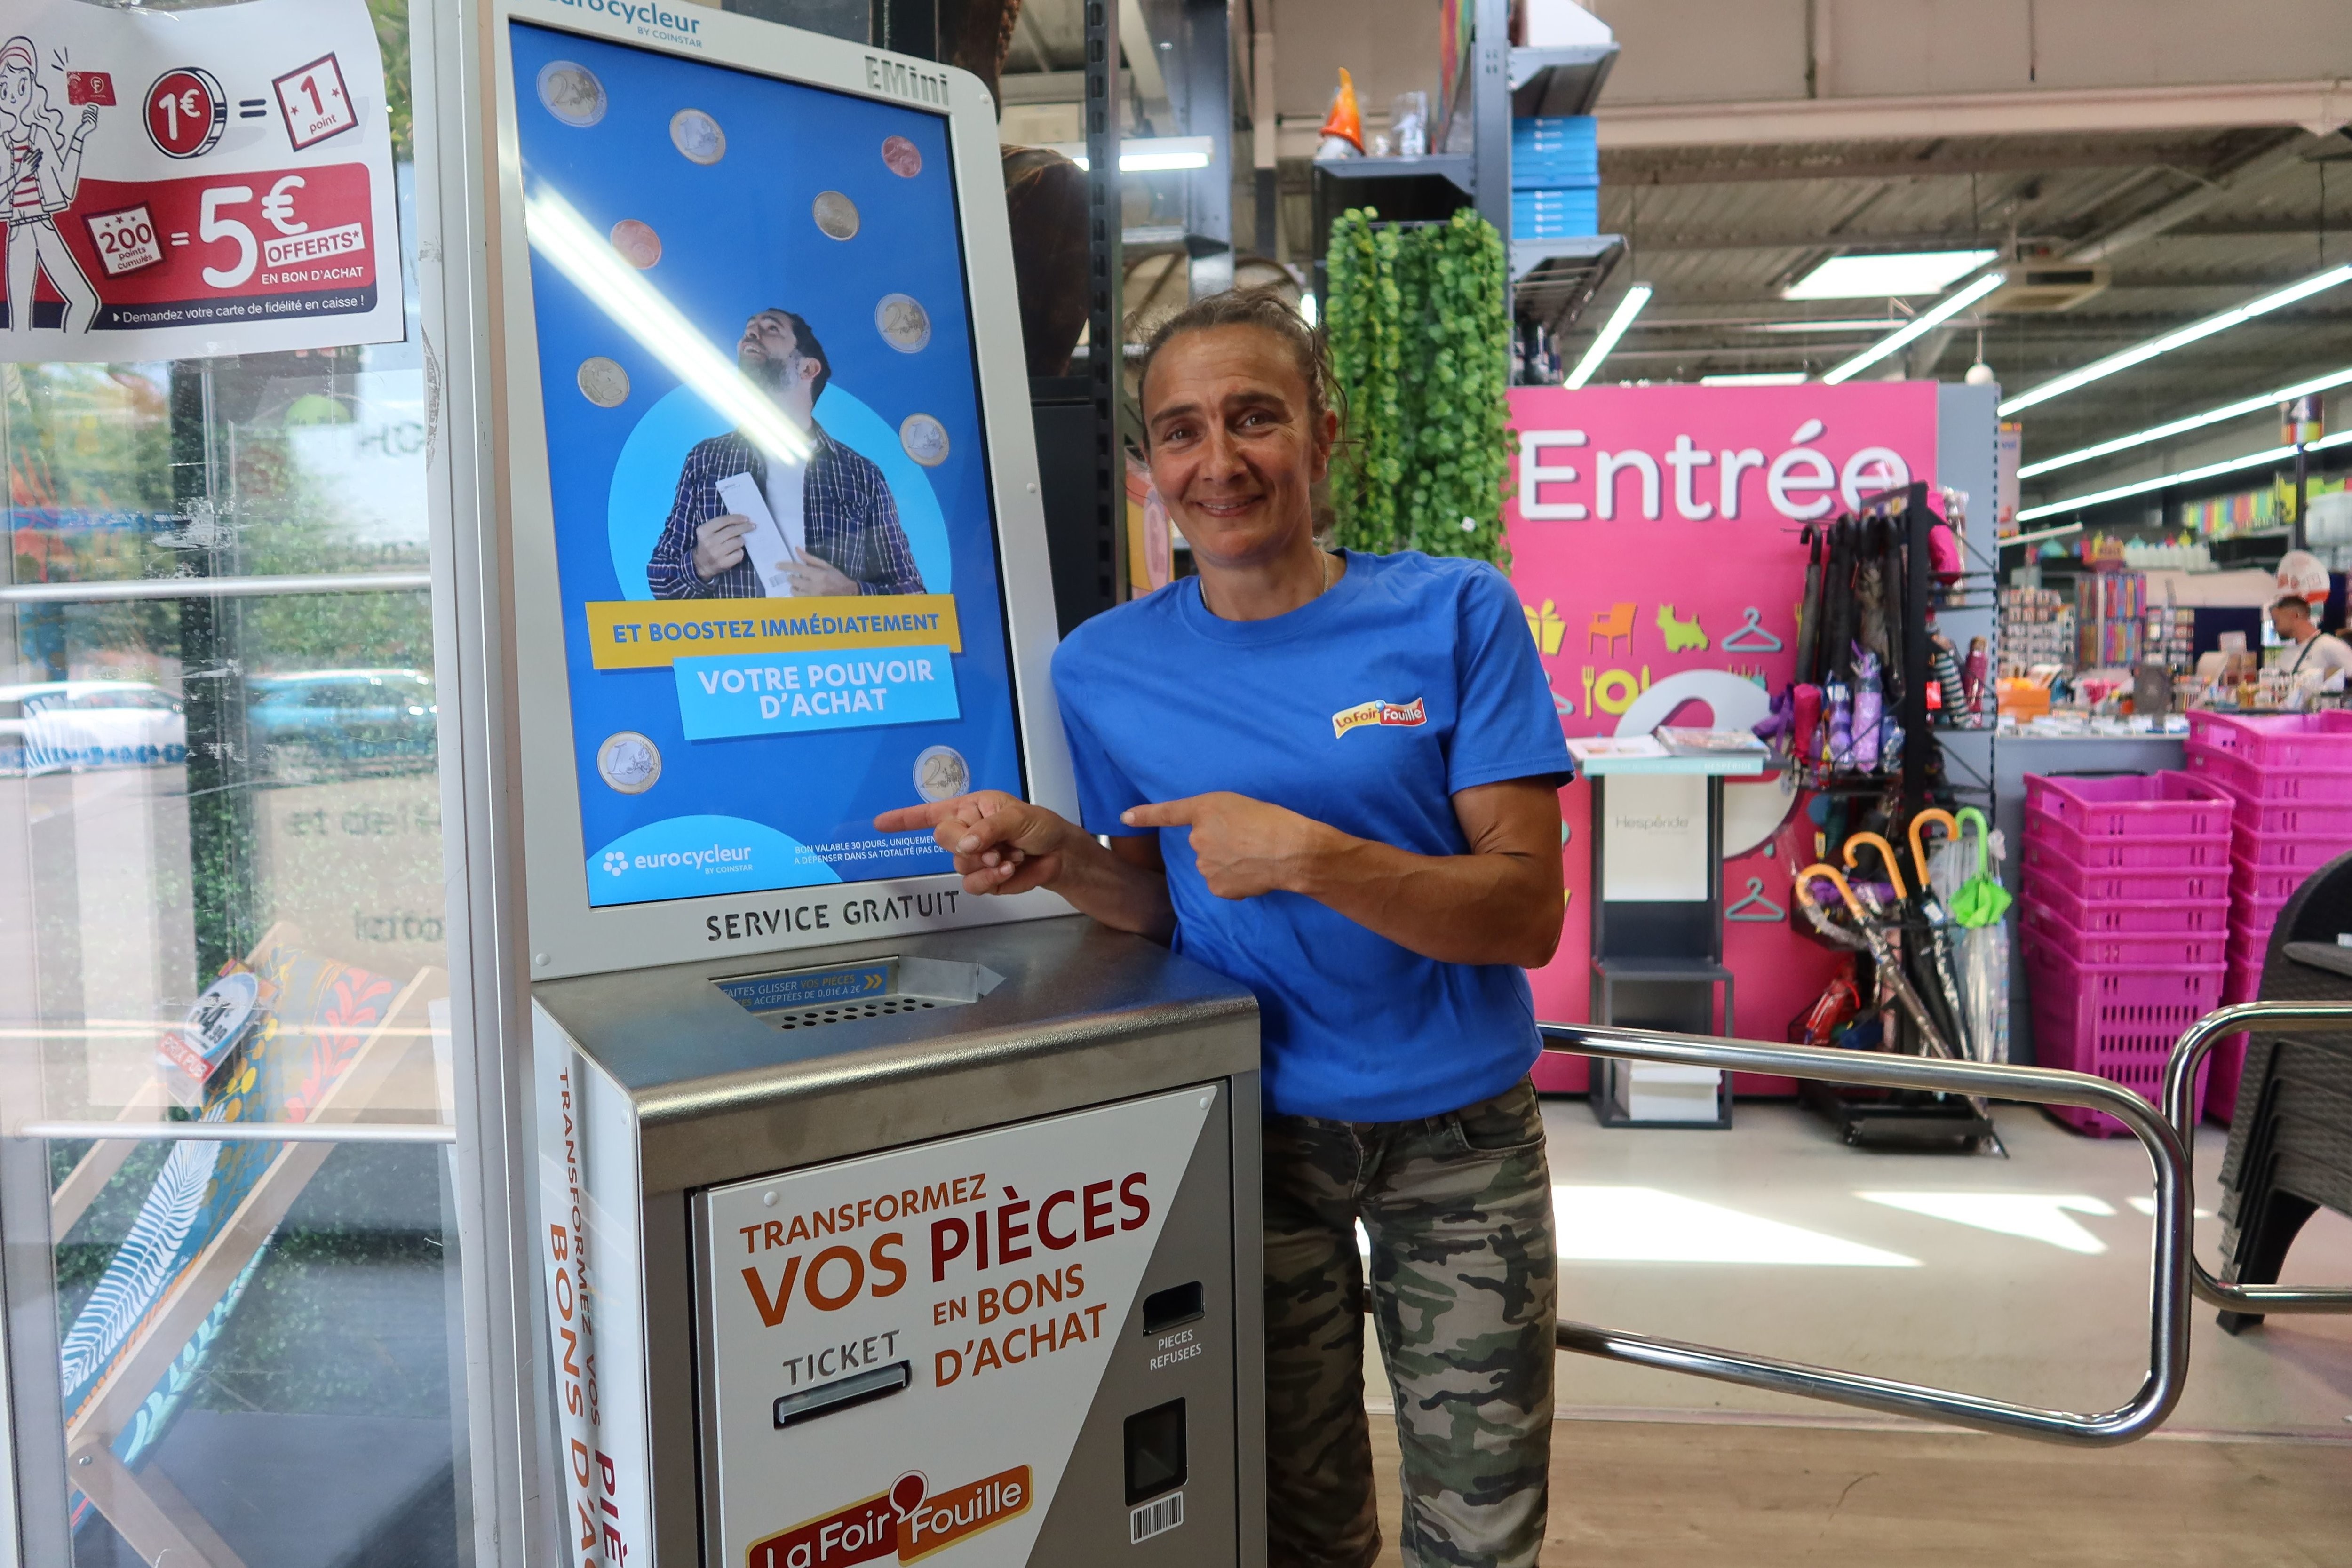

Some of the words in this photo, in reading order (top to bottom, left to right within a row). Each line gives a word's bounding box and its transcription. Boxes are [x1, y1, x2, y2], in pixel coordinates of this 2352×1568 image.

[549, 0, 700, 34] ocycleur
[637, 26, 649, 36] BY
[652, 29, 702, 48] COINSTAR
[864, 55, 949, 106] EMini
[159, 88, 201, 140] 1€
[300, 75, 323, 115] 1
[309, 114, 337, 134] point
[99, 223, 152, 254] 200
[119, 247, 146, 260] points
[118, 254, 153, 270] cumulés
[262, 273, 278, 285] EN
[281, 270, 308, 283] BON
[311, 266, 364, 281] D'ACHAT
[123, 311, 183, 323] Demandez
[185, 308, 213, 319] votre
[215, 305, 245, 317] carte
[247, 302, 262, 314] de
[264, 300, 302, 313] fidélité
[305, 302, 319, 310] en
[321, 298, 358, 310] caisse
[1518, 418, 1910, 521] Entrée
[613, 624, 641, 643] ET
[649, 618, 756, 641] BOOSTEZ
[761, 612, 939, 637] IMMÉDIATEMENT
[697, 666, 800, 695] VOTRE
[809, 659, 934, 691] POUVOIR
[760, 687, 887, 720] D'ACHAT
[1383, 708, 1422, 722] Fouille
[634, 844, 752, 870] eurocycleur
[795, 844, 813, 854] BON
[815, 842, 850, 853] VALABLE
[851, 841, 861, 849] 30
[861, 839, 889, 852] JOURS,
[844, 852, 866, 860] DANS
[879, 845, 914, 858] TOTALITÉ
[915, 845, 932, 856] (PAS
[715, 864, 753, 874] COINSTAR
[707, 902, 830, 942] SERVICE
[842, 890, 961, 926] GRATUIT
[754, 992, 802, 1006] ACCEPTÉES
[804, 990, 815, 999] DE
[817, 987, 841, 997] 0.01€
[850, 984, 861, 994] 2€
[758, 981, 797, 995] GLISSER
[801, 979, 818, 988] VOS
[739, 1172, 987, 1254] TRANSFORMEZ
[559, 1066, 592, 1337] TRANSFORMEZ
[586, 1353, 601, 1427] VOS
[740, 1232, 907, 1328] VOS
[930, 1171, 1151, 1283] PIÈCES
[933, 1296, 967, 1326] EN
[978, 1263, 1085, 1326] BONS
[549, 1223, 584, 1418] BONS
[934, 1302, 1108, 1389] D'ACHAT
[1158, 1329, 1193, 1351] PIECES
[782, 1329, 901, 1387] TICKET
[1150, 1343, 1202, 1371] REFUSEES
[911, 1480, 1022, 1544] Fouille
